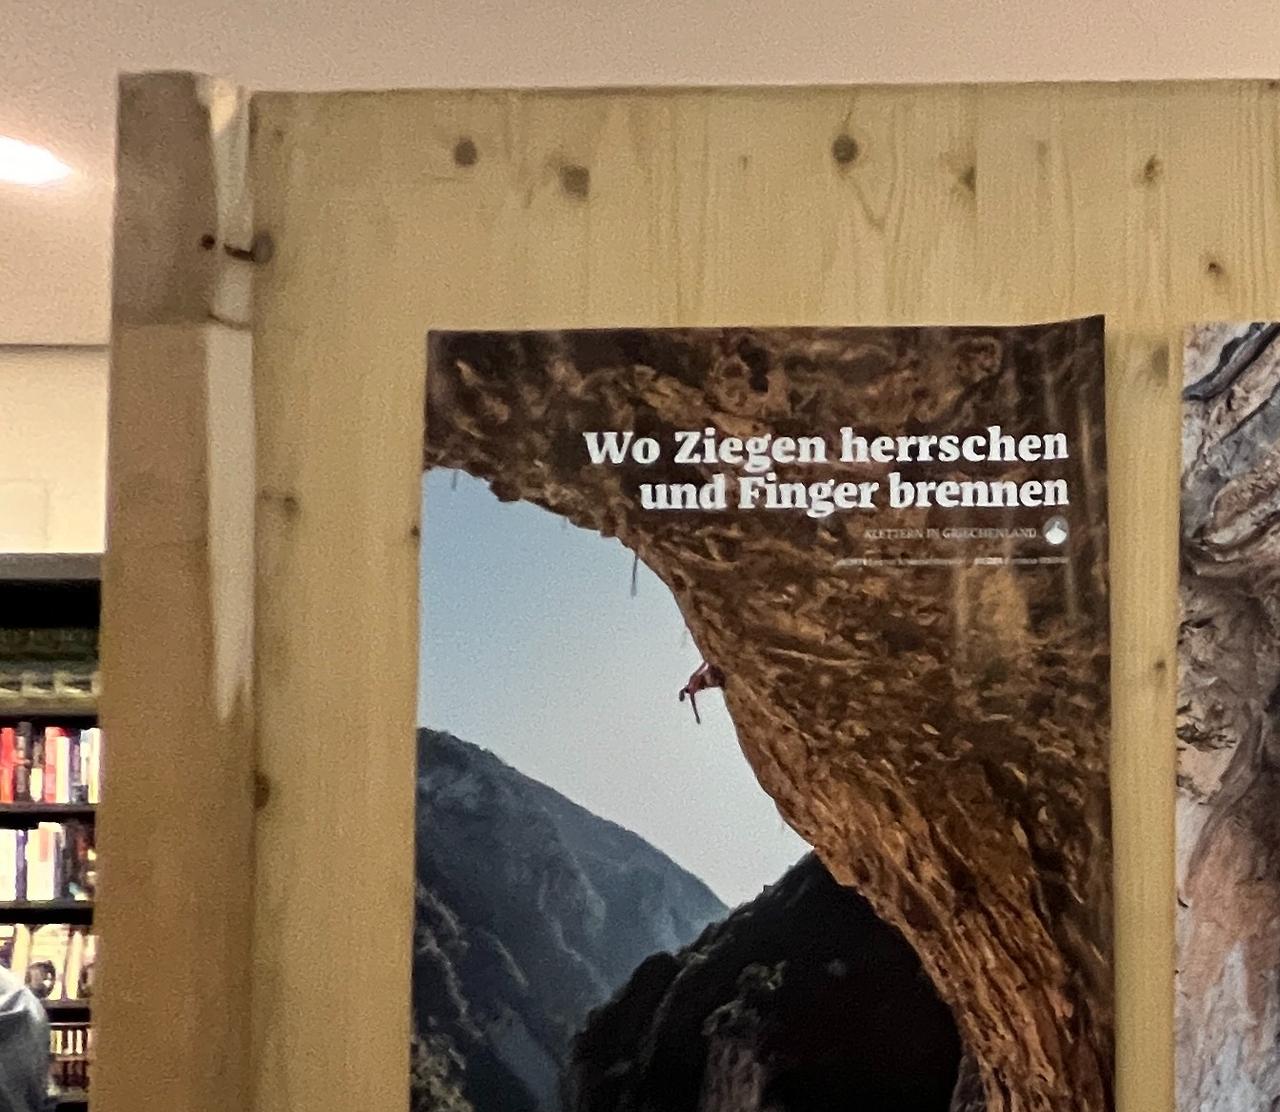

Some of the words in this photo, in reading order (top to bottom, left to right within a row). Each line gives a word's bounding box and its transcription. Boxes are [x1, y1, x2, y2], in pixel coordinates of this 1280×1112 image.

[582, 431, 660, 465] Wo
[674, 427, 827, 473] Ziegen
[840, 426, 1070, 463] herrschen
[639, 473, 727, 510] und
[737, 472, 880, 518] Finger
[888, 472, 1070, 508] brennen
